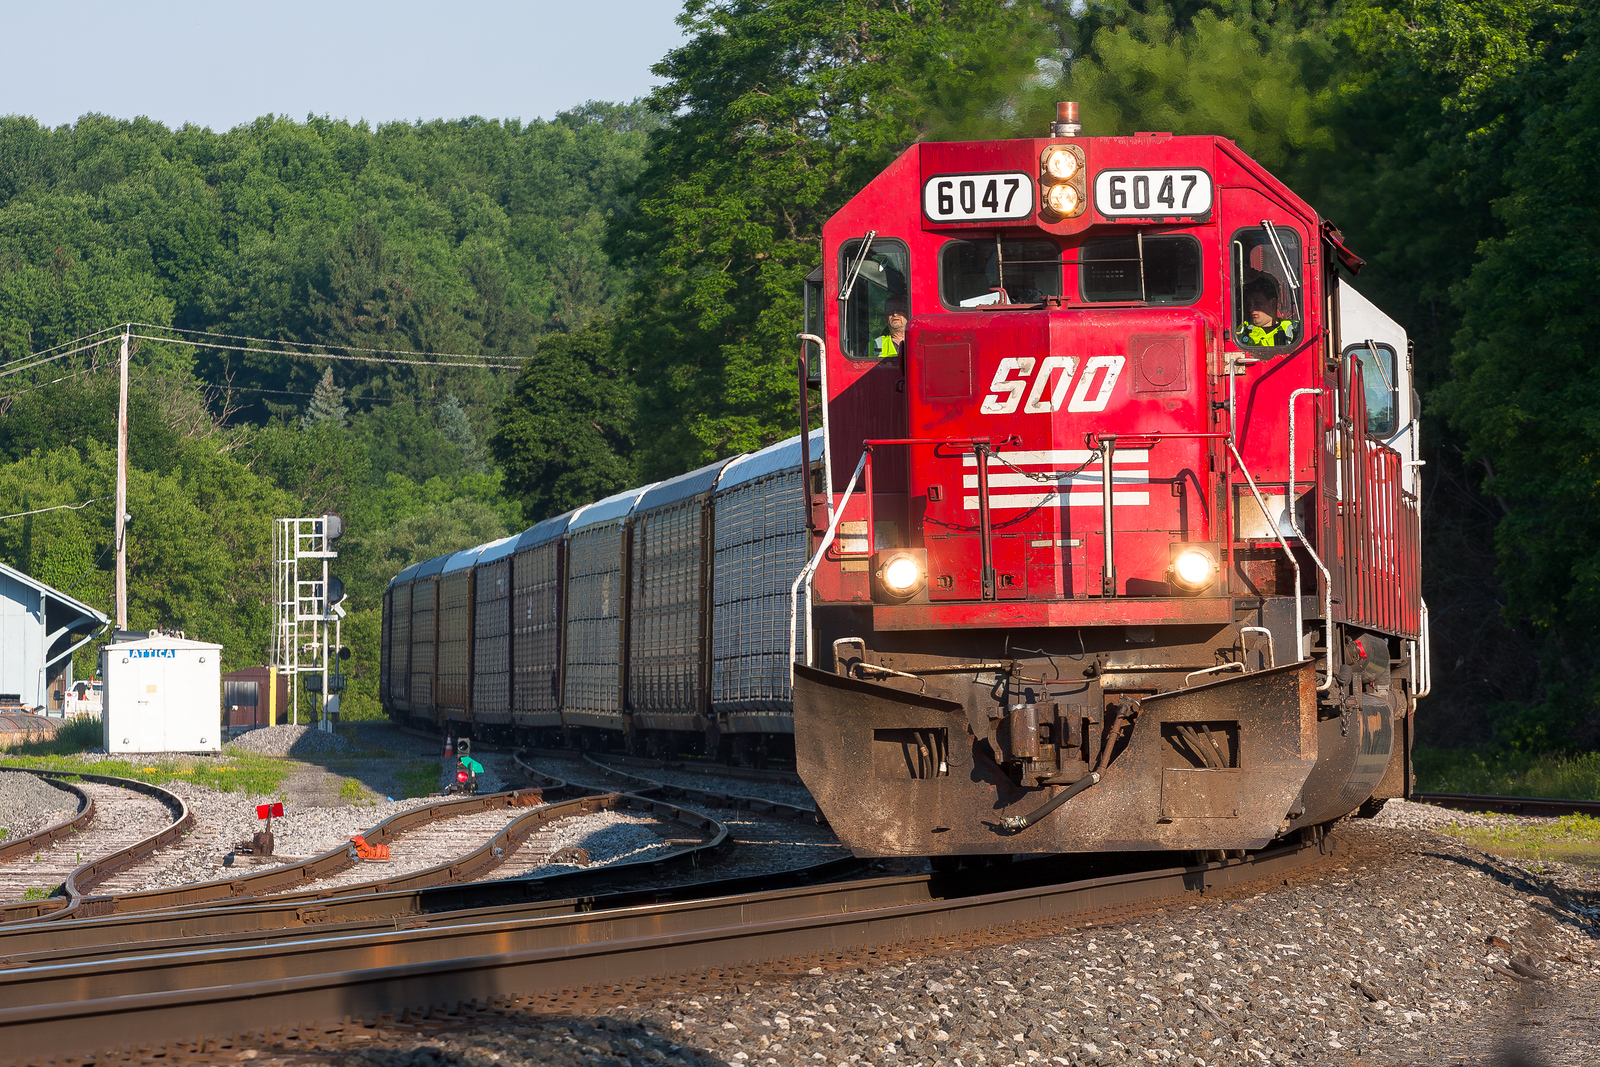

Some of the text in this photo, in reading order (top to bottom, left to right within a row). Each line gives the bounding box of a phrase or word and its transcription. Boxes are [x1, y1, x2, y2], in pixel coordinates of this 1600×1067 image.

[937, 178, 1020, 215] 6047
[1109, 174, 1198, 210] 6047
[979, 355, 1126, 415] SOO
[131, 649, 174, 658] ATTICA
